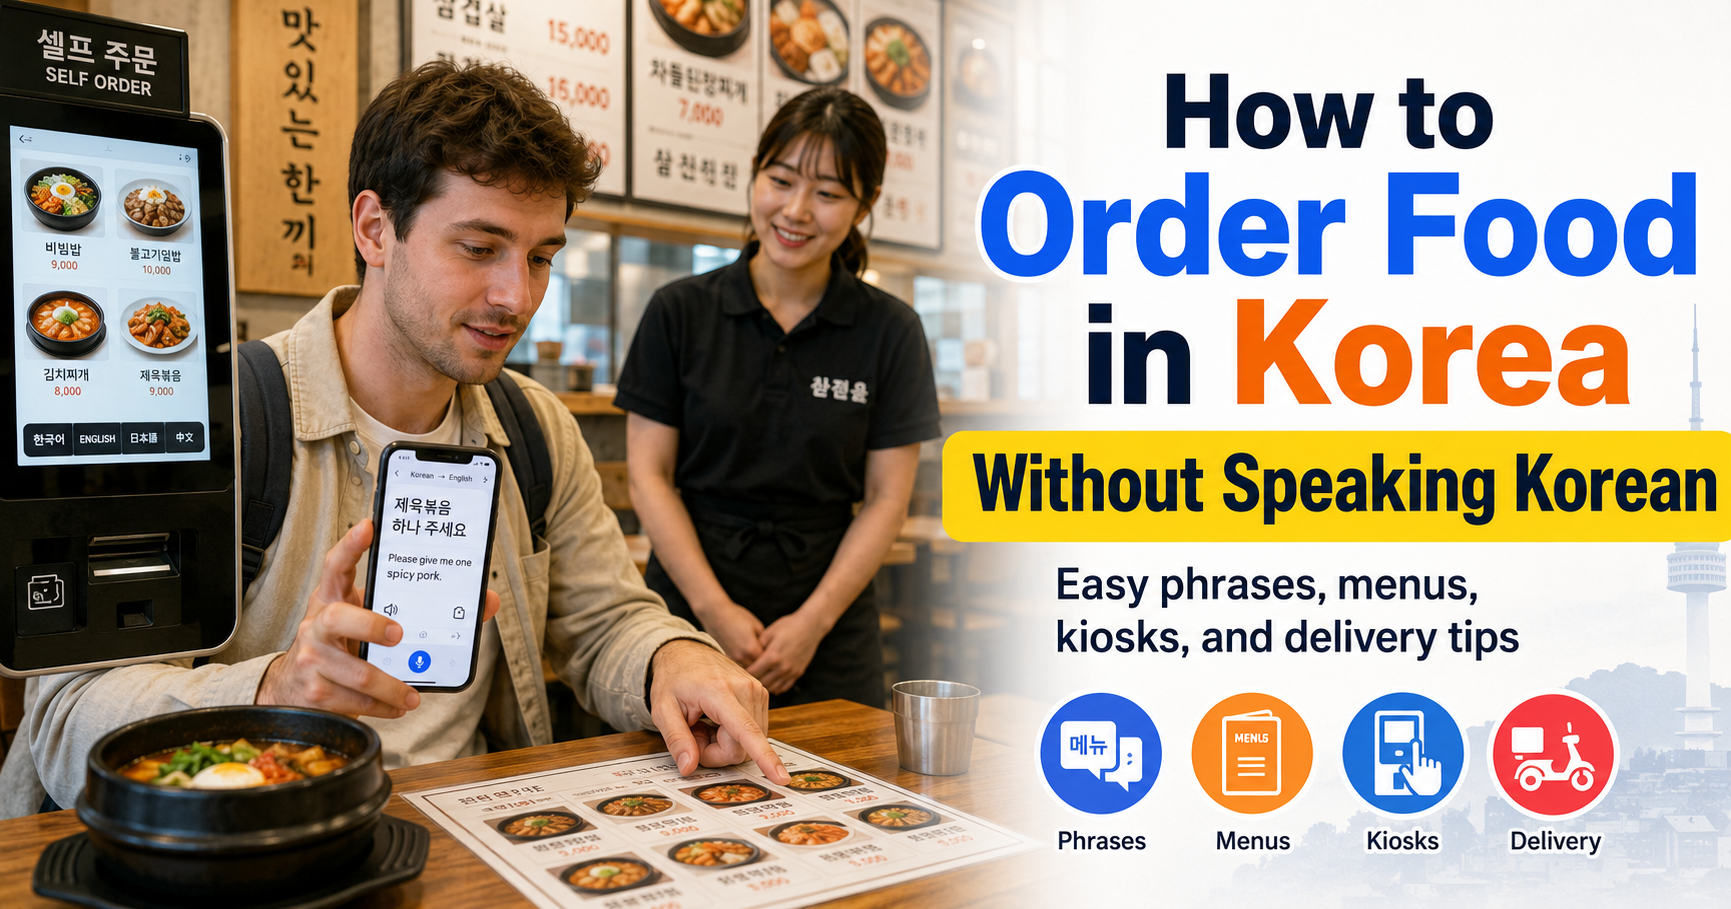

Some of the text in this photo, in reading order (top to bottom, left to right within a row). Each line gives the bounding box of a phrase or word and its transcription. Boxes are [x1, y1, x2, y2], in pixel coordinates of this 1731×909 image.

[549, 20, 610, 55] 15,000
[37, 29, 158, 76] 셀프 주문
[46, 67, 152, 96] SELF ORDER
[45, 241, 82, 257] 비빔밥
[51, 260, 78, 271] 9,000
[143, 265, 171, 275] 10,000
[43, 368, 89, 382] 김치찌개
[54, 386, 82, 397] 8,000
[149, 386, 174, 396] 9,000
[33, 433, 65, 446] 한국어
[79, 434, 116, 444] ENGLISH
[175, 431, 194, 443] 中文
[410, 471, 473, 483] Korean English
[392, 518, 467, 537] 하나 주세요
[388, 553, 472, 567] Please give me one
[387, 569, 442, 581] spicy pork.
